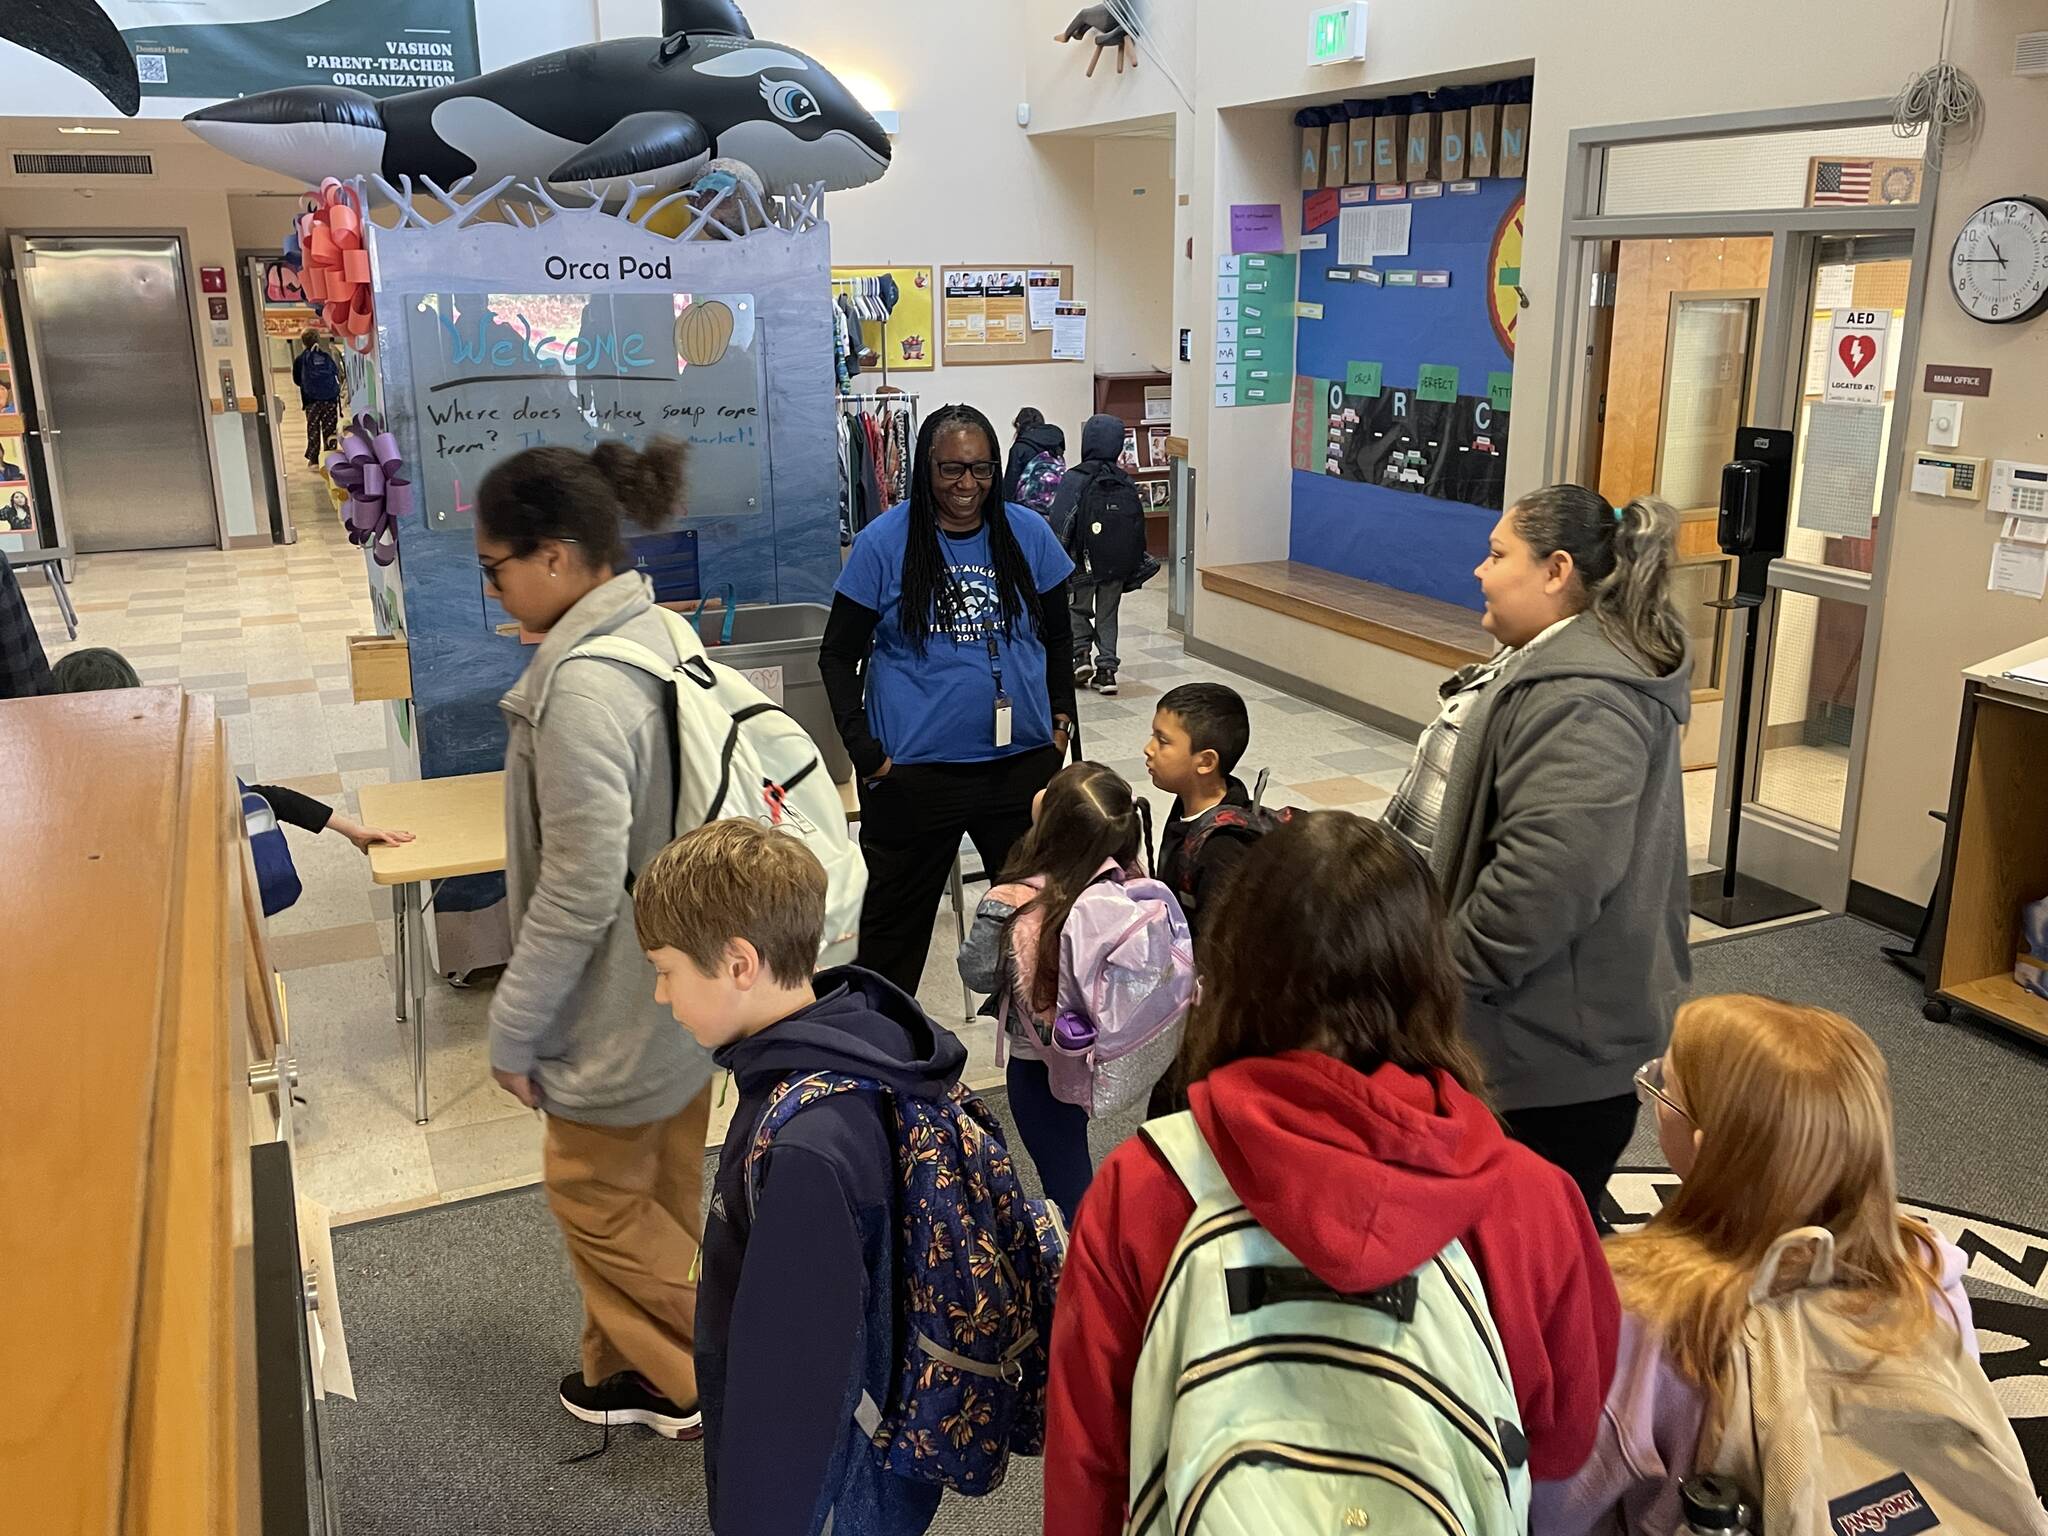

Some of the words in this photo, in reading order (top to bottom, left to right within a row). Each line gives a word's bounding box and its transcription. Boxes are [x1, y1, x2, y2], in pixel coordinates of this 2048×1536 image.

[385, 41, 453, 56] VASHON
[305, 55, 455, 72] PARENT-TEACHER
[332, 72, 456, 87] ORGANIZATION
[1983, 210, 1995, 223] 11
[2004, 204, 2018, 218] 12
[2029, 211, 2035, 224] 1
[1964, 229, 1977, 242] 10
[1957, 253, 1965, 266] 9
[544, 255, 609, 280] Orca
[619, 255, 672, 280] Pod
[1959, 278, 1967, 291] 8
[2032, 281, 2040, 292] 4
[1972, 297, 1980, 309] 7
[2013, 299, 2021, 312] 5
[1224, 306, 1232, 316] 2
[1991, 304, 1999, 317] 6
[1847, 312, 1875, 324] AED
[1222, 370, 1229, 380] 4
[1933, 375, 1952, 383] MAIN
[1953, 376, 1980, 385] OFFICE
[1831, 382, 1863, 390] LOCATED
[427, 398, 500, 426] Where
[513, 396, 561, 420] does
[662, 404, 706, 428] soup
[436, 429, 499, 459] from?
[1836, 1488, 1920, 1536] JANSPORT
